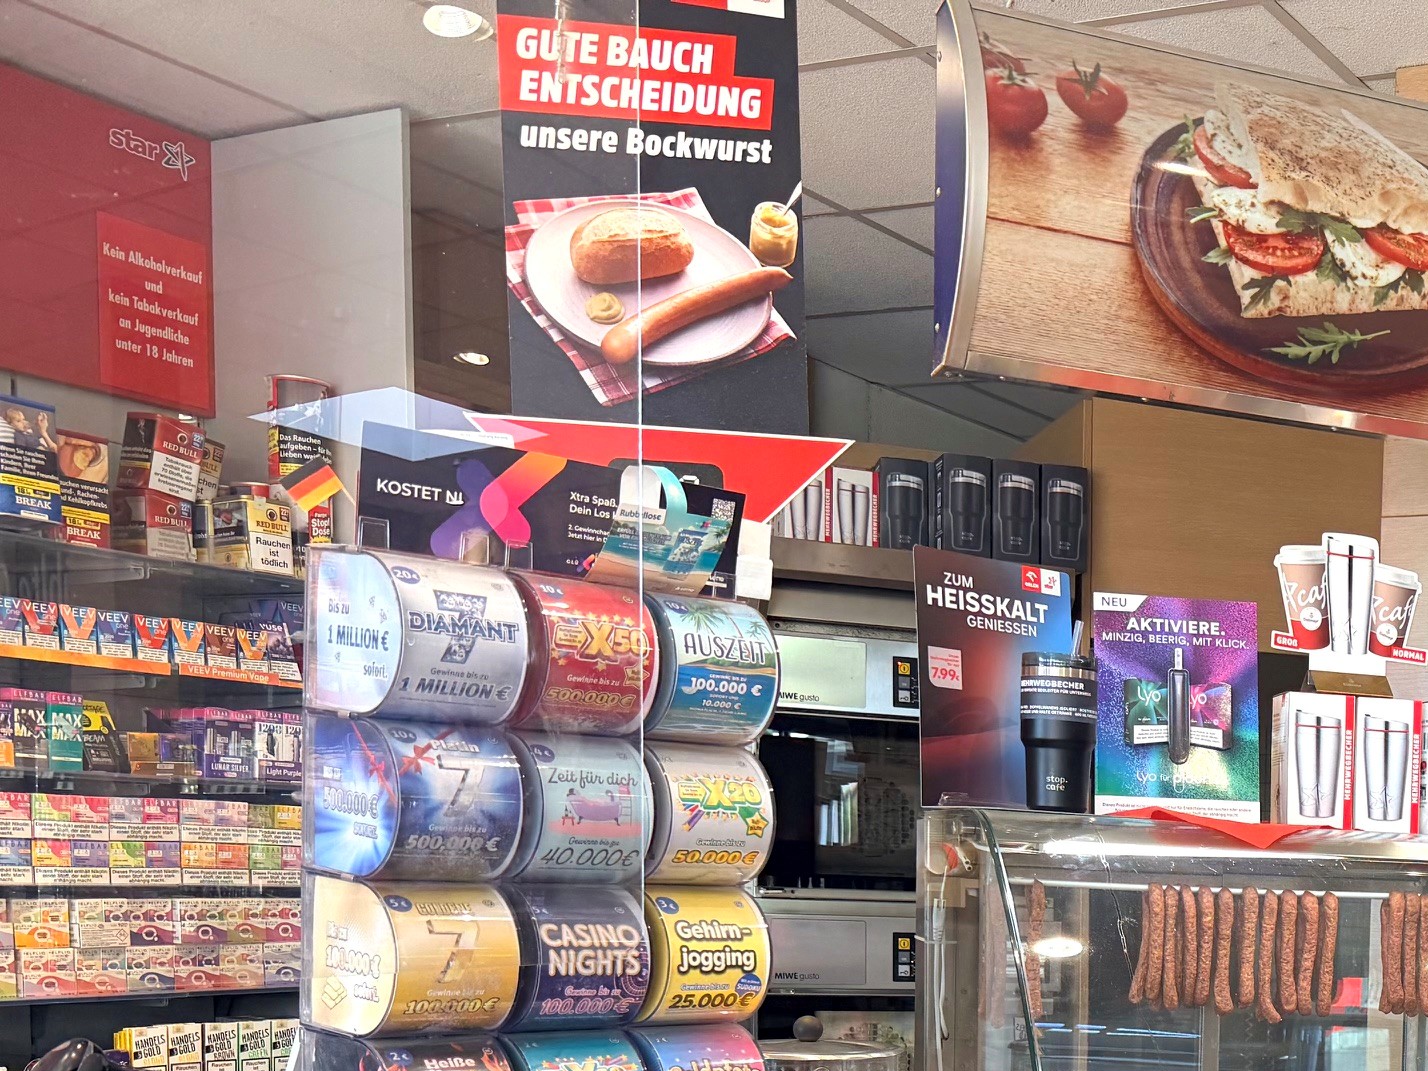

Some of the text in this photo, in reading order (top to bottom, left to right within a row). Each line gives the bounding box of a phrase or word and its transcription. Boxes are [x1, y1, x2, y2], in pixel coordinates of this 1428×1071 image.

[515, 27, 714, 75] GUTE BAUCH
[518, 70, 762, 119] ENTSCHEIDUNG
[109, 128, 159, 161] star
[520, 124, 773, 164] unsere Bockwurst
[103, 242, 203, 285] Kein Alkoholverkauf
[145, 281, 163, 294] und
[108, 289, 199, 326] kein Tabakverkauf
[119, 317, 190, 346] an Jugendliche
[115, 338, 194, 368] unter 18 Jahren
[293, 435, 321, 445] Rauchen
[178, 445, 199, 459] BULL
[376, 479, 441, 500] KOSTET
[569, 491, 590, 504] Xtra
[15, 495, 52, 511] BREAK
[569, 504, 611, 519] Dein Los
[67, 526, 101, 540] BREAK
[256, 520, 289, 532] RED BULL
[256, 537, 291, 550] Rauchen
[269, 549, 279, 558] ist
[261, 557, 288, 569] tödlich
[944, 572, 974, 588] ZUM
[23, 600, 57, 614] VEEV
[926, 585, 1049, 624] HEISSKALT
[1101, 597, 1127, 608] NEU
[98, 611, 129, 623] VEEV
[137, 616, 168, 629] VEEV
[206, 626, 235, 637] VEEV
[408, 611, 519, 643] DIAMANT
[967, 615, 1039, 637] GENIESSEN
[1126, 617, 1226, 636] AKTIVIERE.
[336, 625, 379, 650] MILLION
[1102, 632, 1250, 650] MINZIG, BEERIG, MIT KLICK.
[684, 633, 766, 664] AUSZEIT
[1393, 649, 1424, 661] NORMAL
[188, 665, 270, 683] VEEV Premium Vape
[13, 690, 45, 700] ELFBAR
[399, 677, 512, 701] 1 MILLION €
[1343, 729, 1352, 801] MEHRWEGBECHER
[1411, 733, 1420, 803] MEHRWEGBECHER
[548, 767, 638, 788] Zeit für dich
[1160, 773, 1170, 782] für
[540, 923, 640, 948] CASINO
[676, 920, 752, 941] Gehirn-
[549, 950, 641, 977] NIGHTS
[678, 946, 756, 974] jogging
[774, 971, 820, 982] MIWE gusto
[668, 993, 738, 1009] 25.000
[135, 1032, 166, 1050] HANDELS
[207, 1029, 236, 1045] HANDELS
[143, 1046, 161, 1061] GOLD
[215, 1040, 232, 1056] GOLD
[424, 1058, 476, 1070] Heiße
